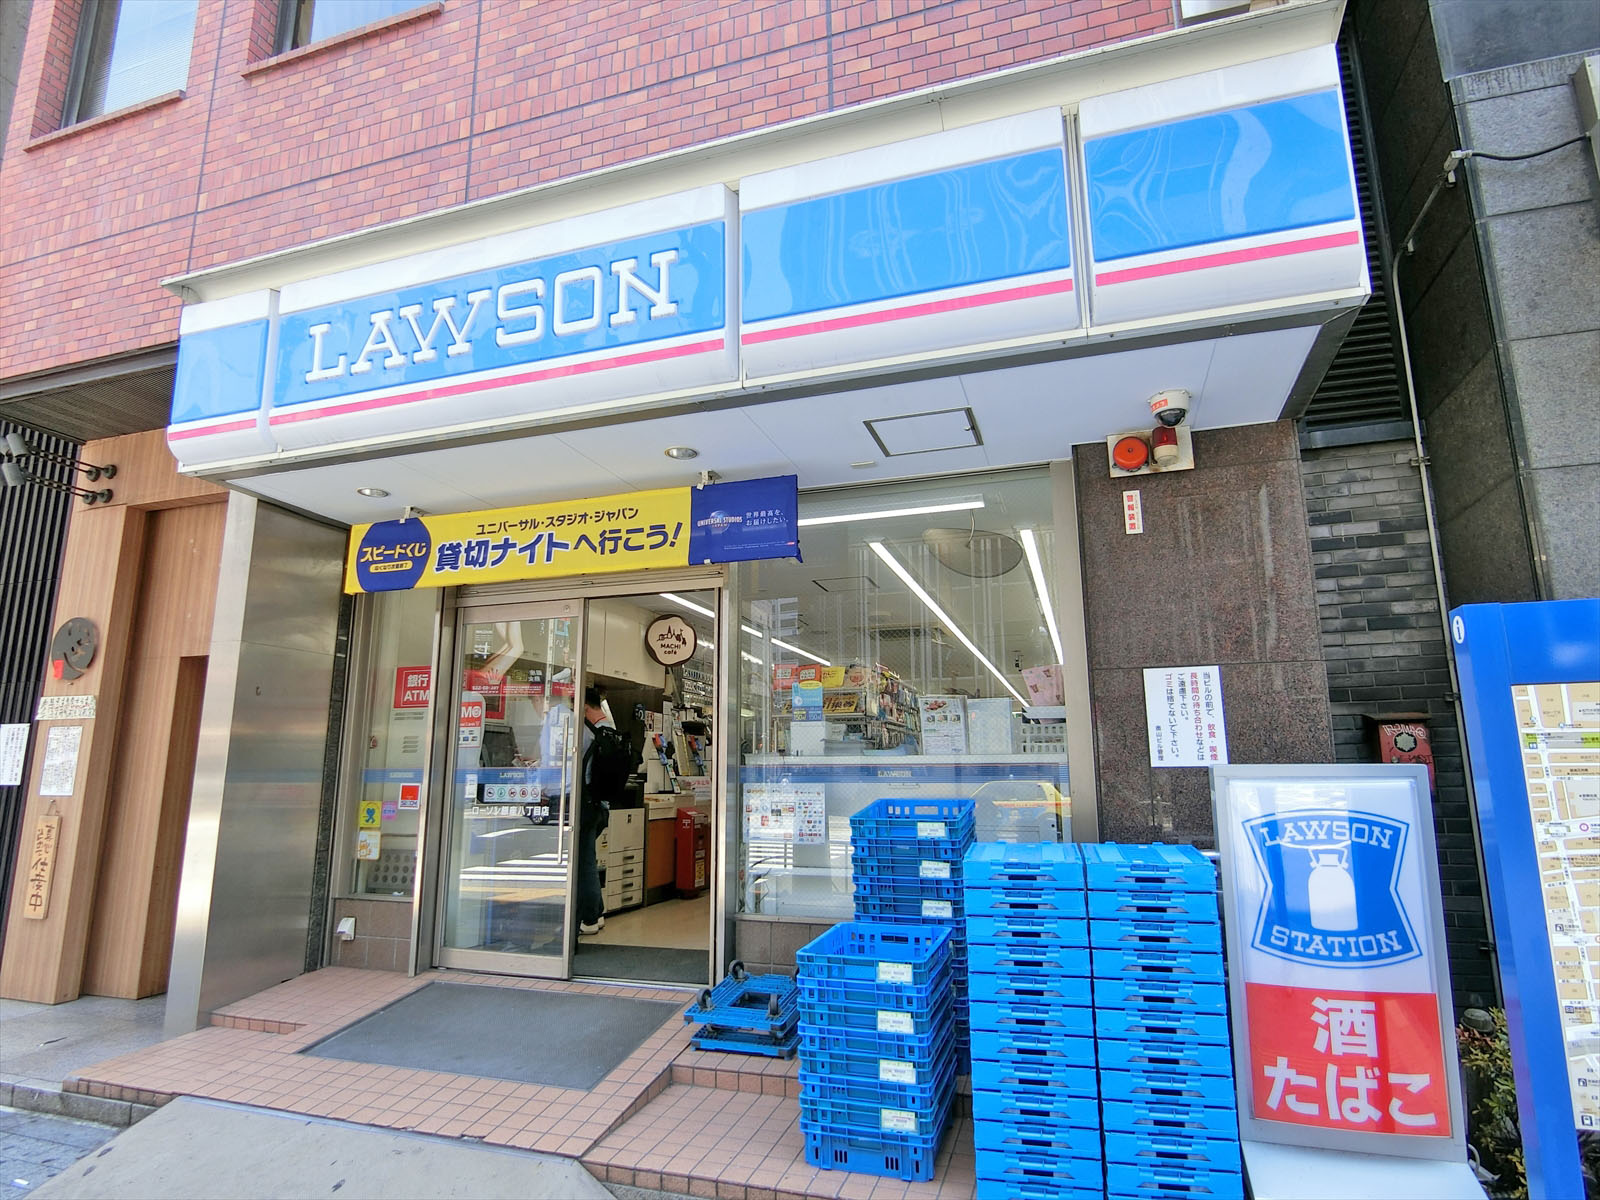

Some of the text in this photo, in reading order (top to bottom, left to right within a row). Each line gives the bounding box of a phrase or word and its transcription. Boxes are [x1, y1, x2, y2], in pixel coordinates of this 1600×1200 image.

[305, 248, 680, 384] LAWSON
[476, 507, 639, 536] ユニバーサル・スタジオ・ジャパン
[360, 543, 427, 563] スピードくじ
[408, 674, 429, 687] 銀行
[403, 690, 430, 702] ATM
[1259, 820, 1394, 849] LAWSON
[1270, 925, 1402, 959] STATION
[1310, 996, 1379, 1058] 酒
[1262, 1055, 1437, 1127] たばこ
